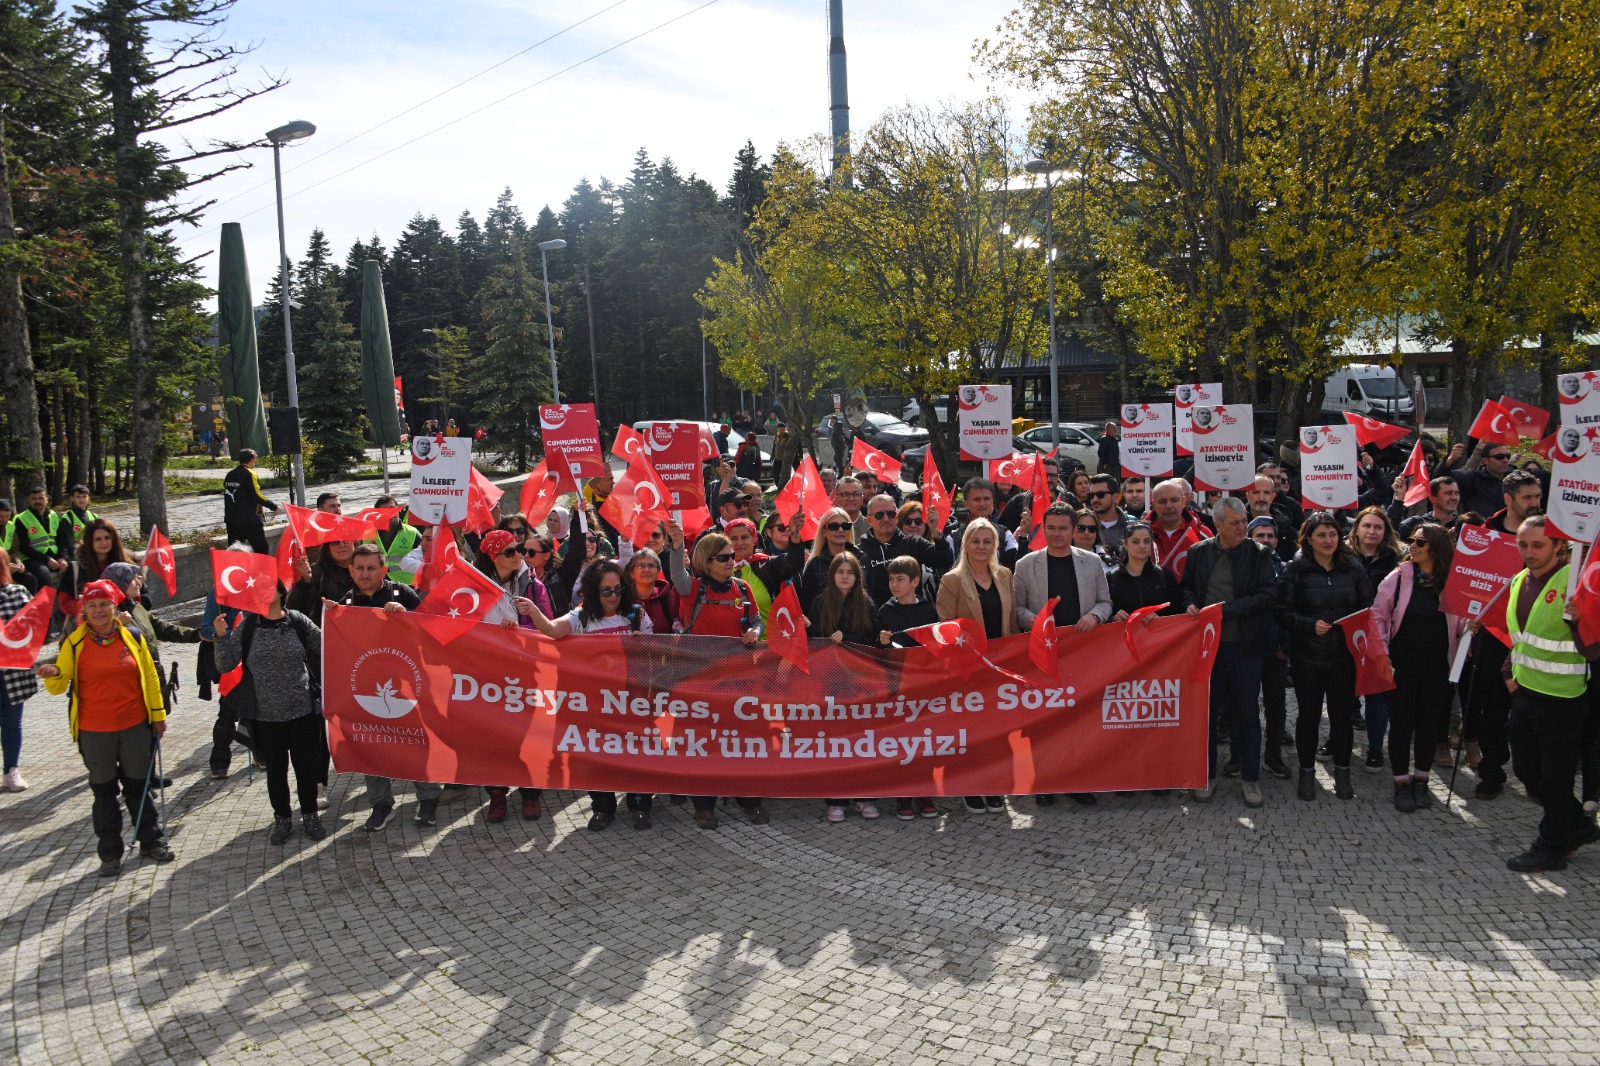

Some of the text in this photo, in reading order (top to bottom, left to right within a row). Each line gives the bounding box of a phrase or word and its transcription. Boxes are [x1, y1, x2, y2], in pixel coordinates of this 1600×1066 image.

[963, 428, 1008, 436] CUMHURİYET
[546, 438, 597, 446] CUMHURİYETLE
[1200, 444, 1248, 453] ATATÜRK'ÜN
[1205, 453, 1244, 463] İZİNDEYİZ
[655, 461, 695, 470] CUMHURİYET
[1313, 464, 1344, 473] YAŞASIN
[422, 476, 456, 486] İLELEBET
[1305, 472, 1353, 480] CUMHURİYET
[1558, 479, 1600, 492] ATATÜRK
[412, 486, 464, 496] CUMHURİYET
[1455, 565, 1512, 585] CUMHURİYE
[1470, 579, 1493, 592] BİZİZ
[355, 647, 391, 669] OSMANGAZİ
[1103, 679, 1180, 699] ERKAN
[452, 674, 1076, 724] Doğaya Nefes, Cumhuriyete Söz:
[1105, 700, 1176, 721] AYDIN
[556, 724, 968, 765] Atatürk'ün İzindeyiz!
